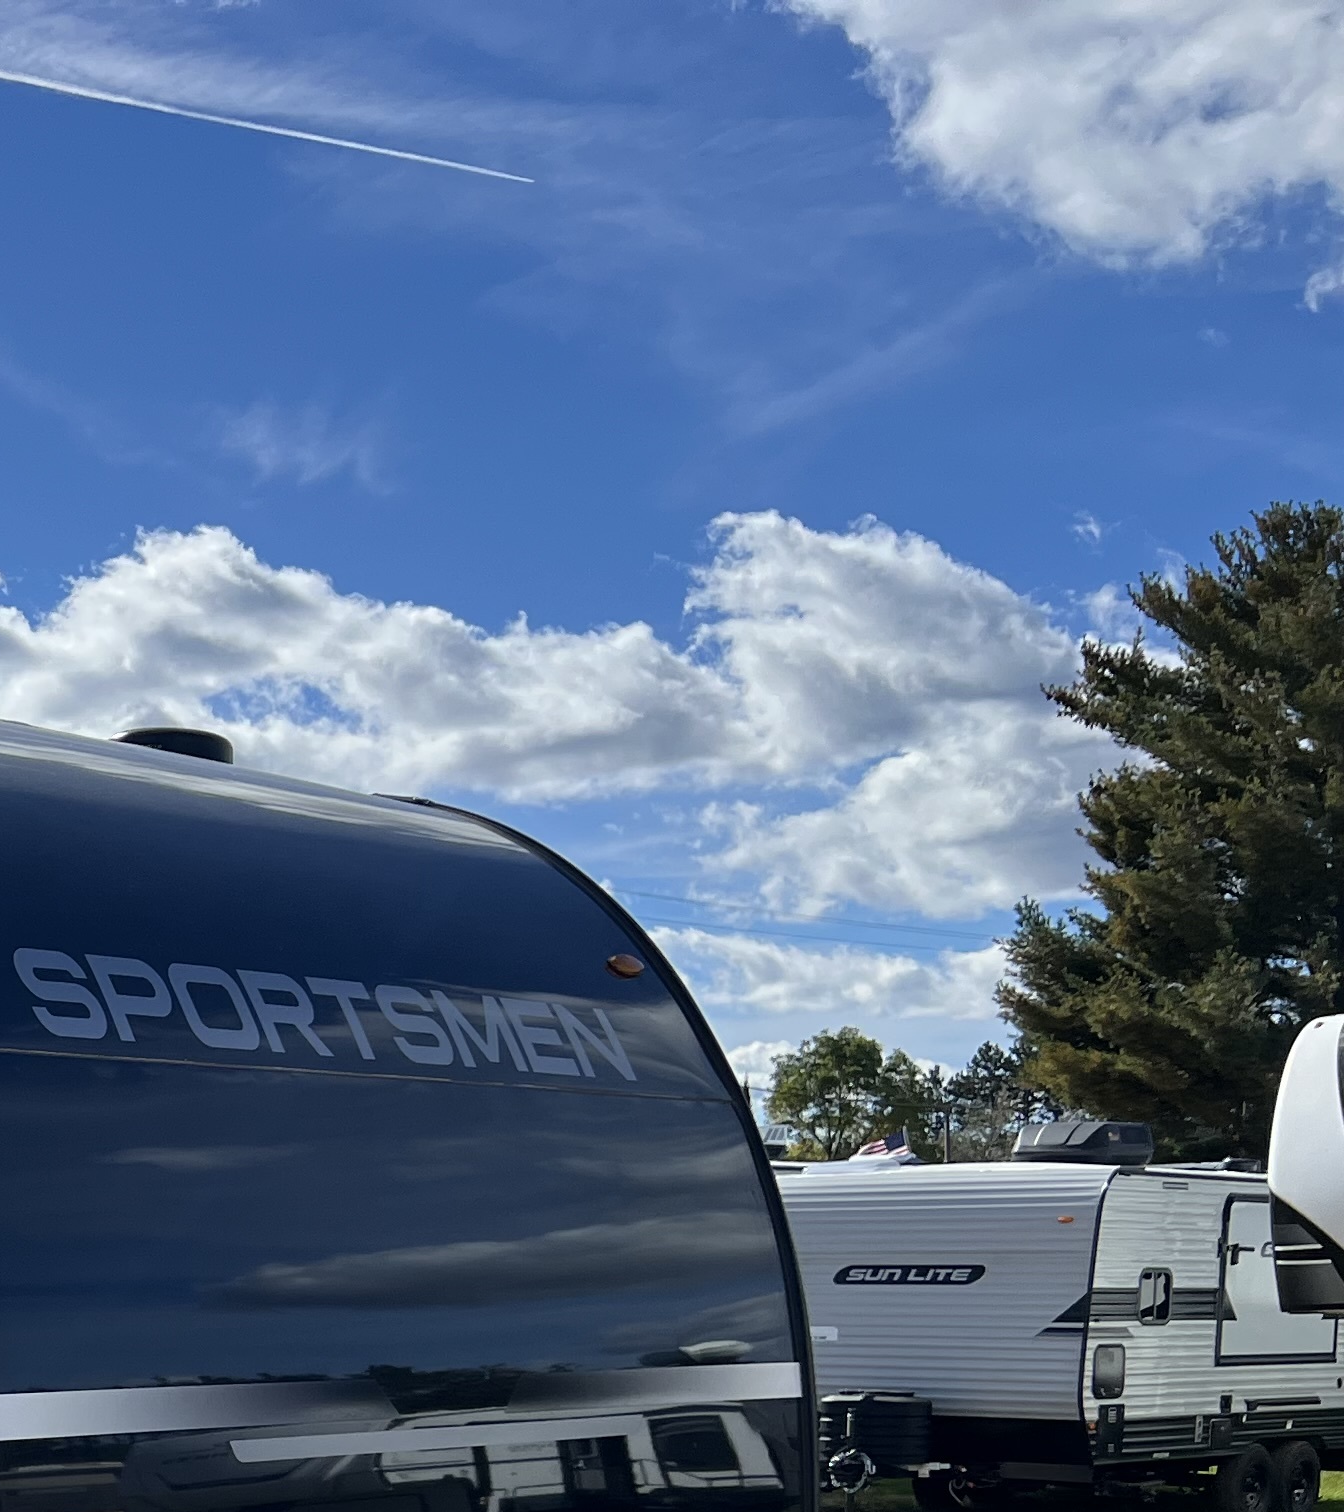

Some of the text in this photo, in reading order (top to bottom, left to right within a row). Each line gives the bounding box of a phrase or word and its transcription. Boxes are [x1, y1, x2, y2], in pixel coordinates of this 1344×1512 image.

[13, 948, 637, 1082] SPORTSMEN
[845, 1268, 972, 1281] SUN LITE
